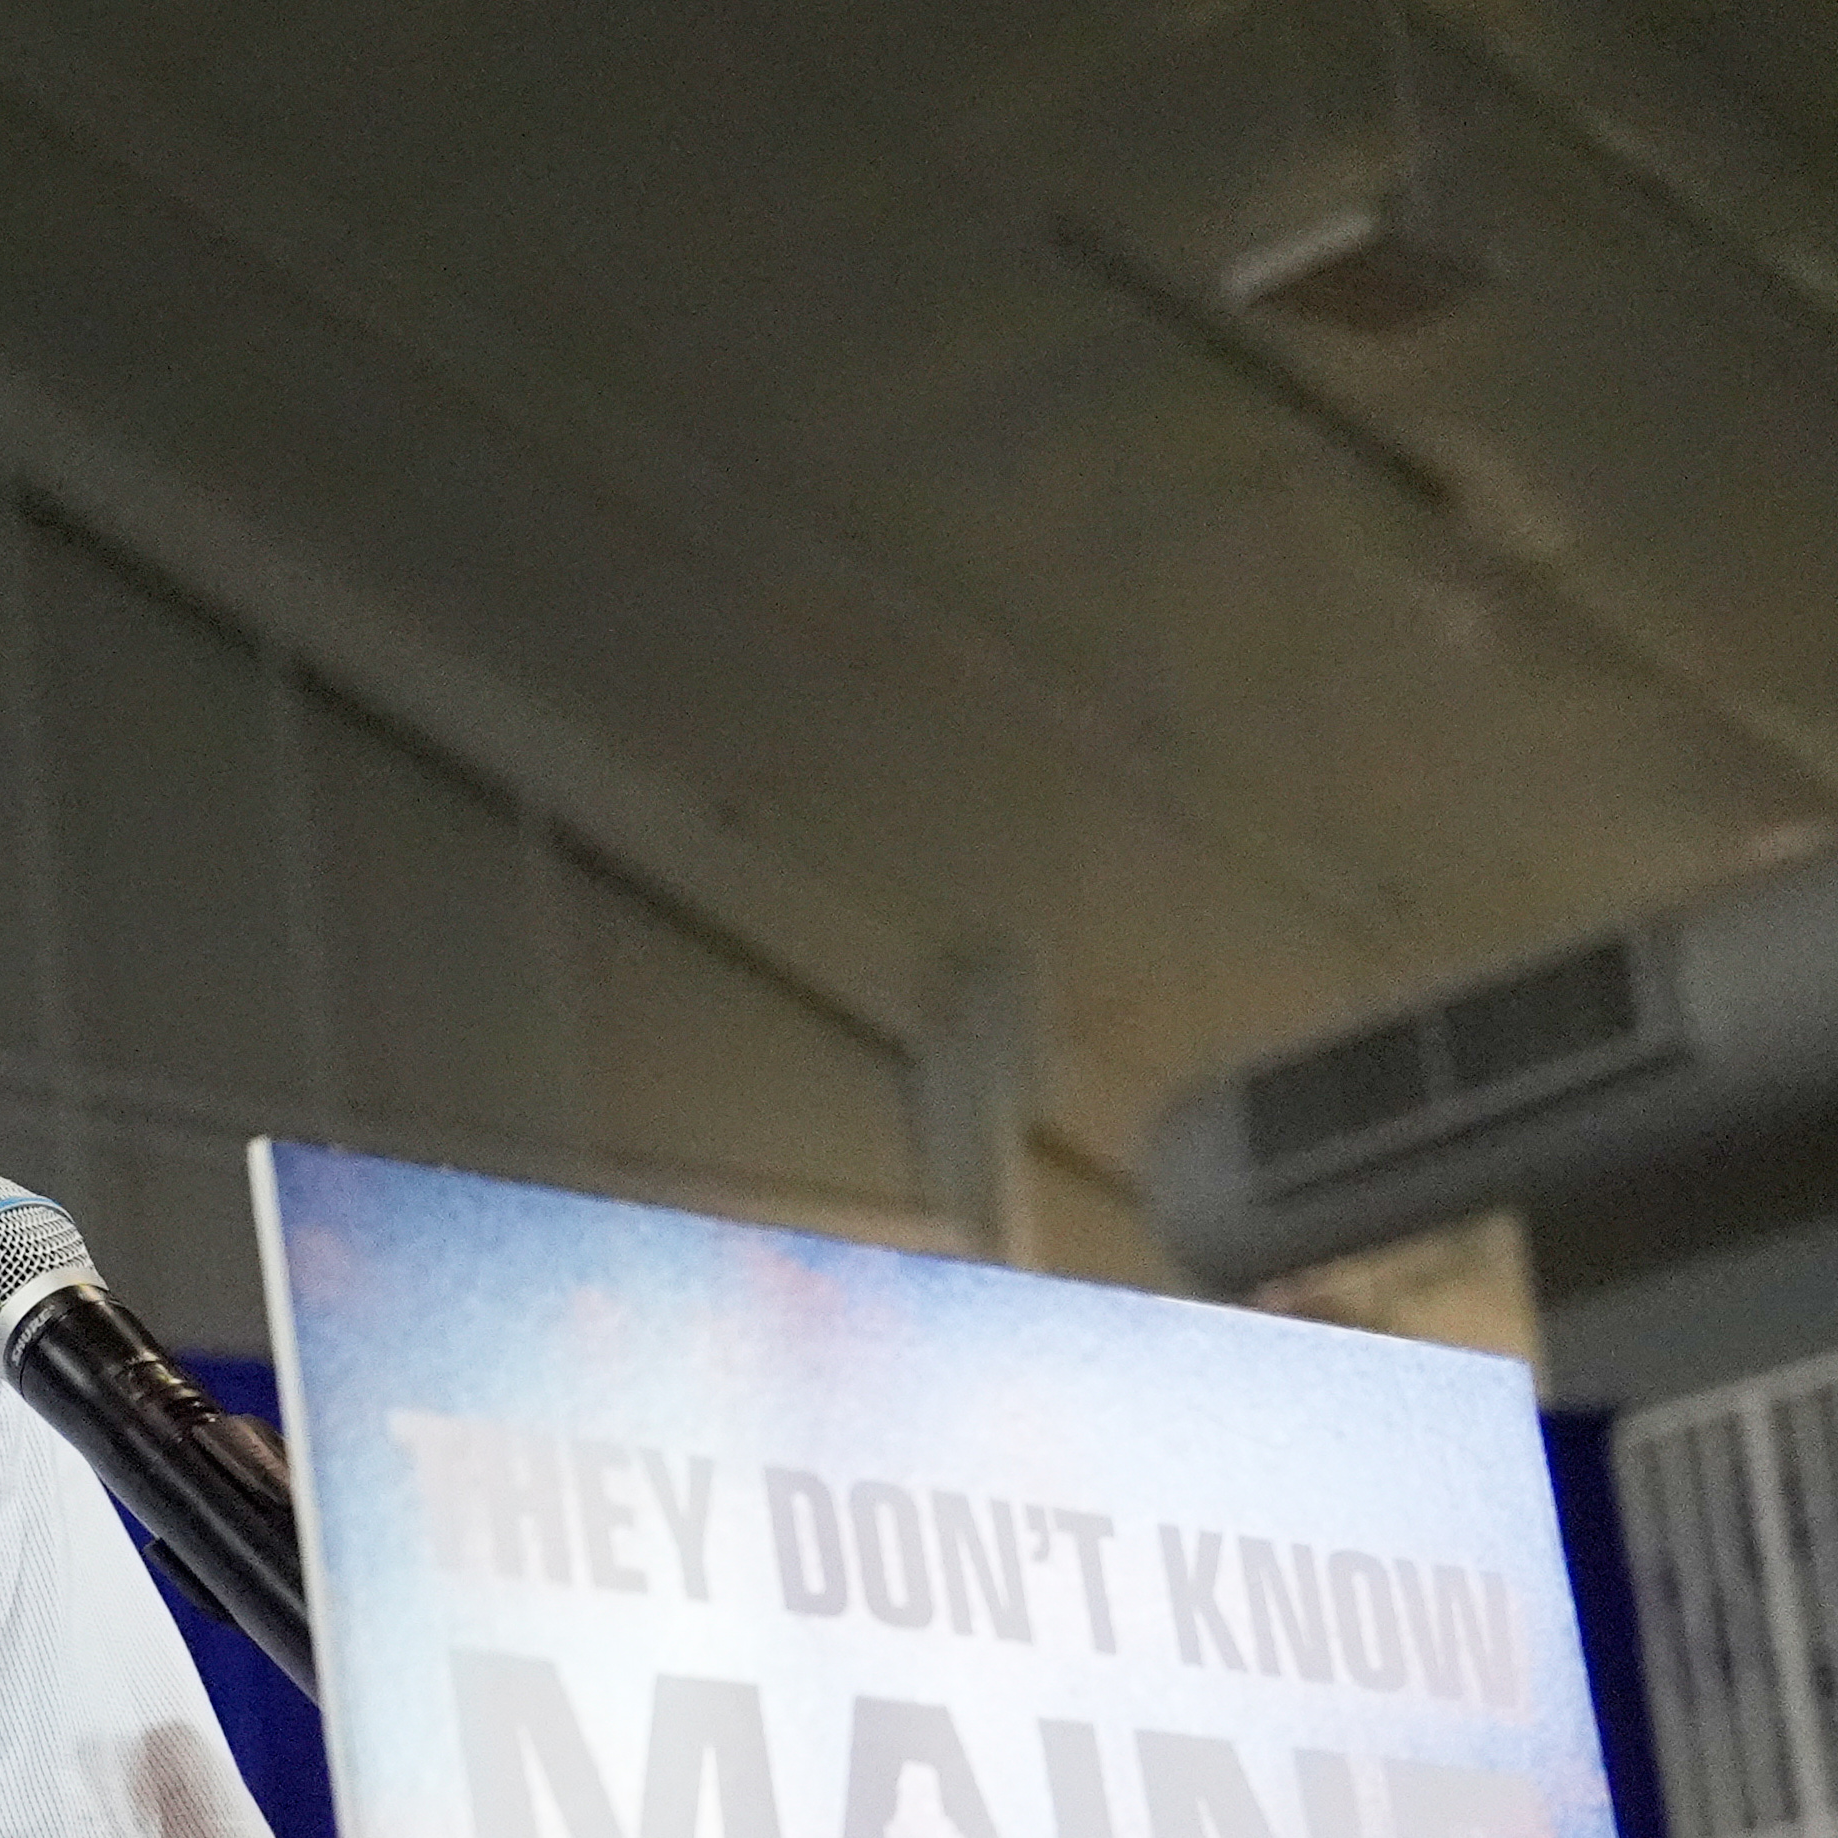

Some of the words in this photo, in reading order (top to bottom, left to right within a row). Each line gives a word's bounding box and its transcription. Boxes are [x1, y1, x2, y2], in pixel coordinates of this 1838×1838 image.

[391, 1410, 715, 1602] THEY
[763, 1464, 1118, 1657] DON'T
[1156, 1522, 1522, 1710] KNOW
